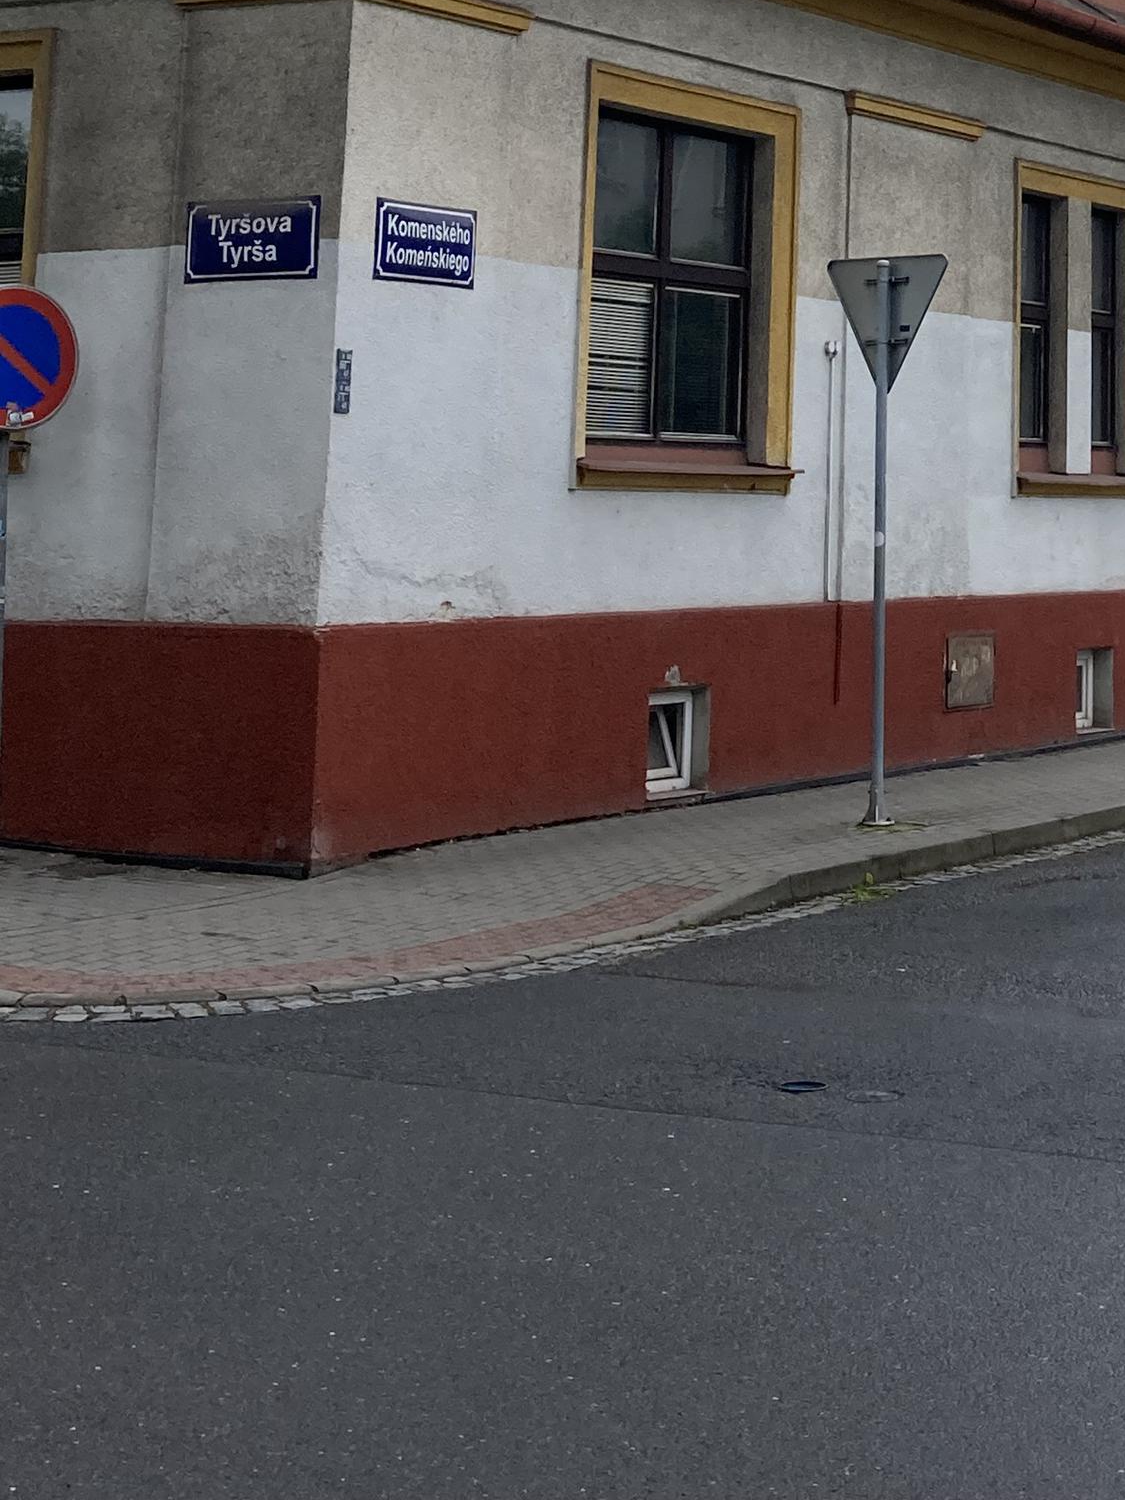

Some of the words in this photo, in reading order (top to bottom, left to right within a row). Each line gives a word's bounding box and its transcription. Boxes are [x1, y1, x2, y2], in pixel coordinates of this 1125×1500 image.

[207, 212, 292, 241] Tyršova
[387, 213, 471, 245] Komenského
[218, 239, 277, 269] Tyrša
[385, 241, 469, 276] Komeńskiego
